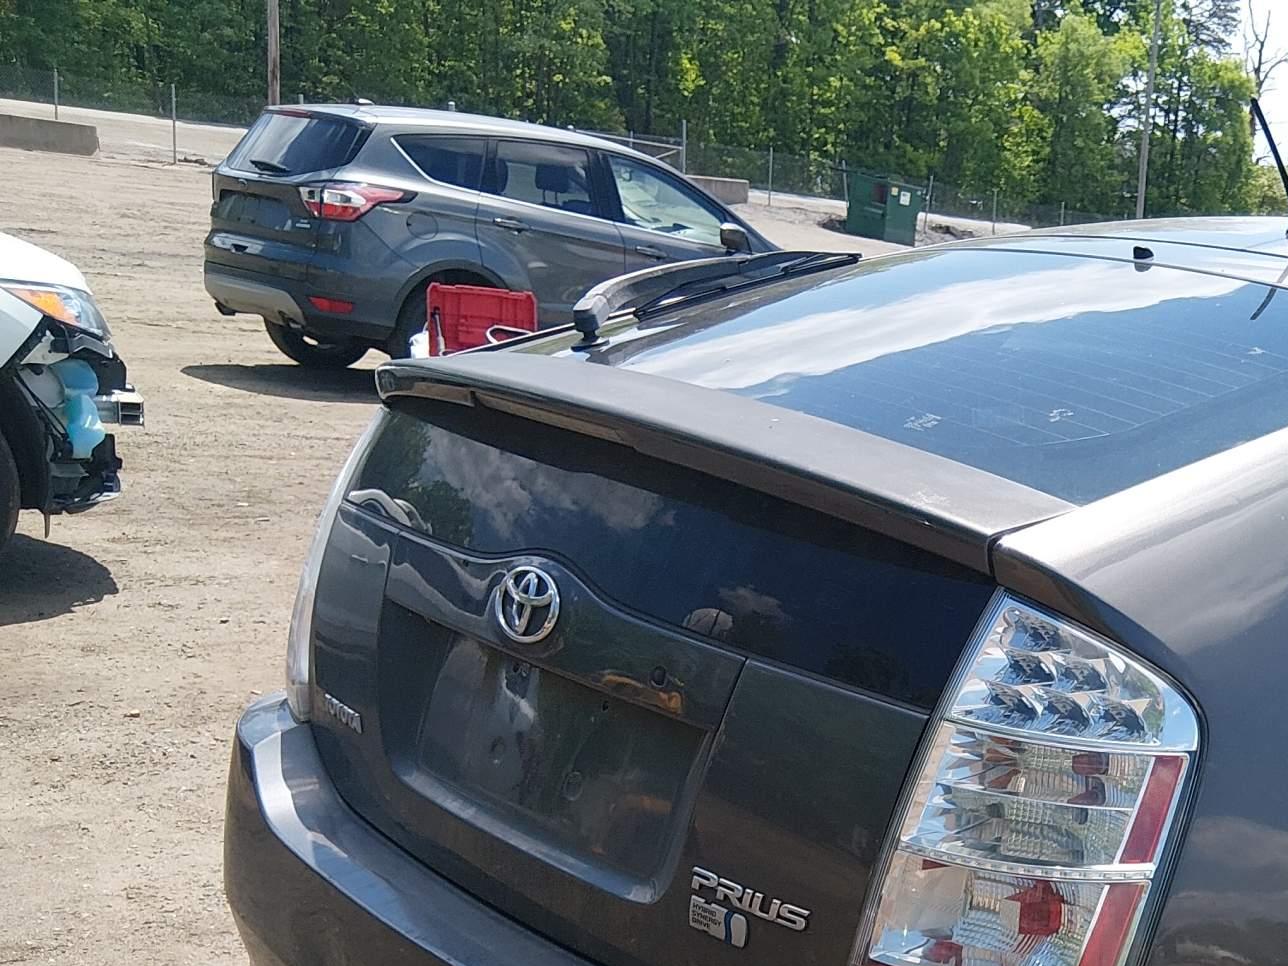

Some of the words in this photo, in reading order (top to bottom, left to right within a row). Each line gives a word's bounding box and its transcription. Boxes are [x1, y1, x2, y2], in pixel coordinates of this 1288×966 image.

[324, 693, 362, 734] TOYOTA
[691, 866, 811, 931] PRIUS
[692, 902, 717, 917] HYBRID
[691, 910, 721, 927] SYNERGY
[691, 917, 711, 928] DRIVE
